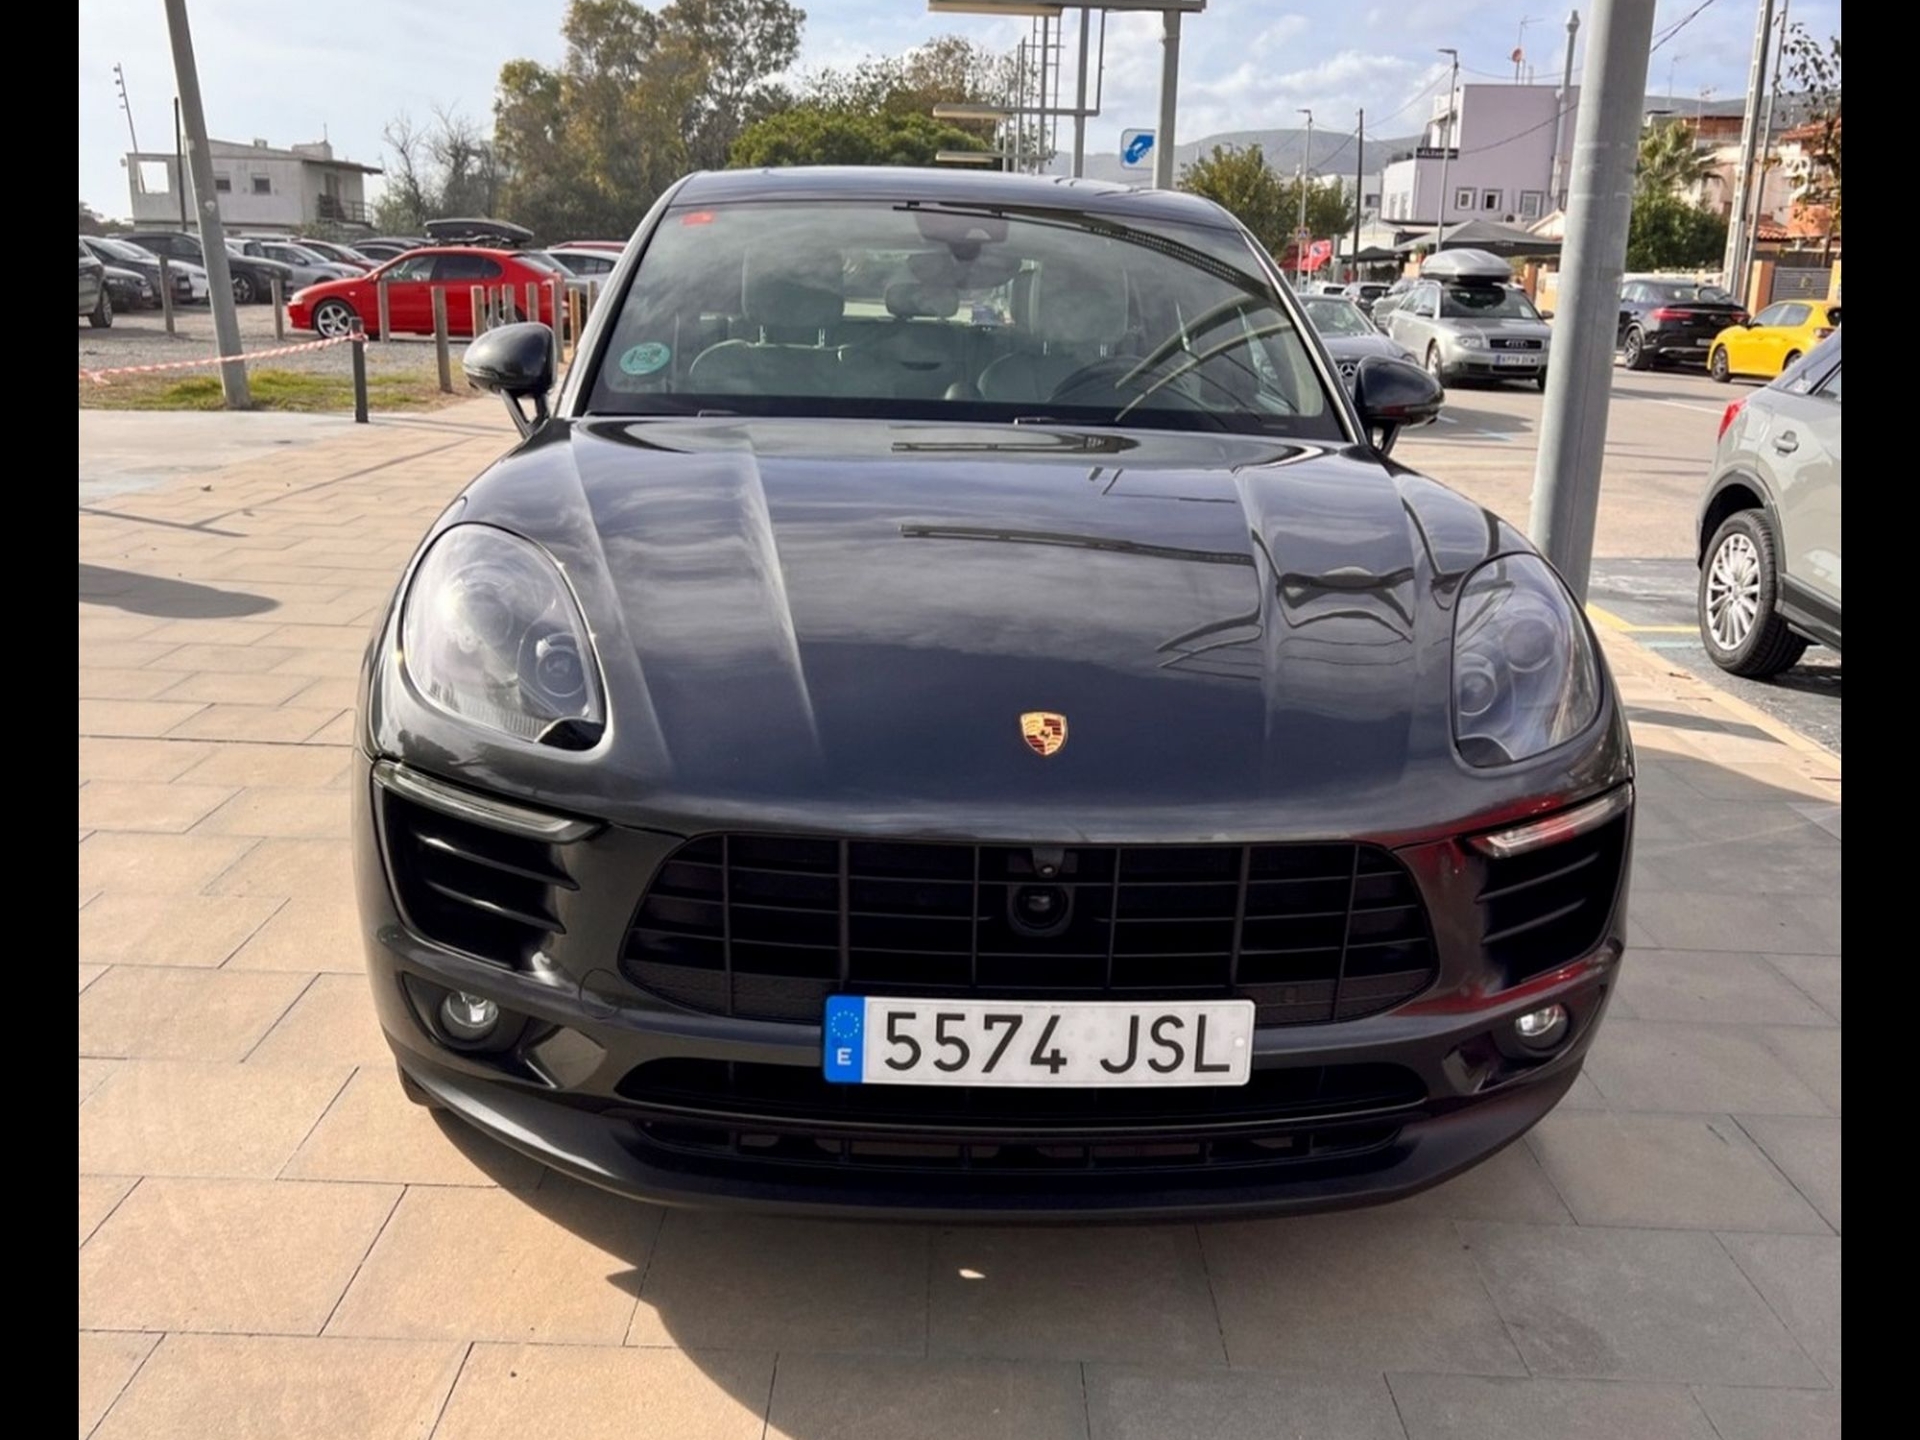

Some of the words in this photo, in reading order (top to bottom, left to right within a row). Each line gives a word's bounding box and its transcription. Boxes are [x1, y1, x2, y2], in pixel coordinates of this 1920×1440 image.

[836, 1047, 853, 1066] E
[884, 1011, 1068, 1074] 5574
[1099, 1013, 1231, 1074] JSL
